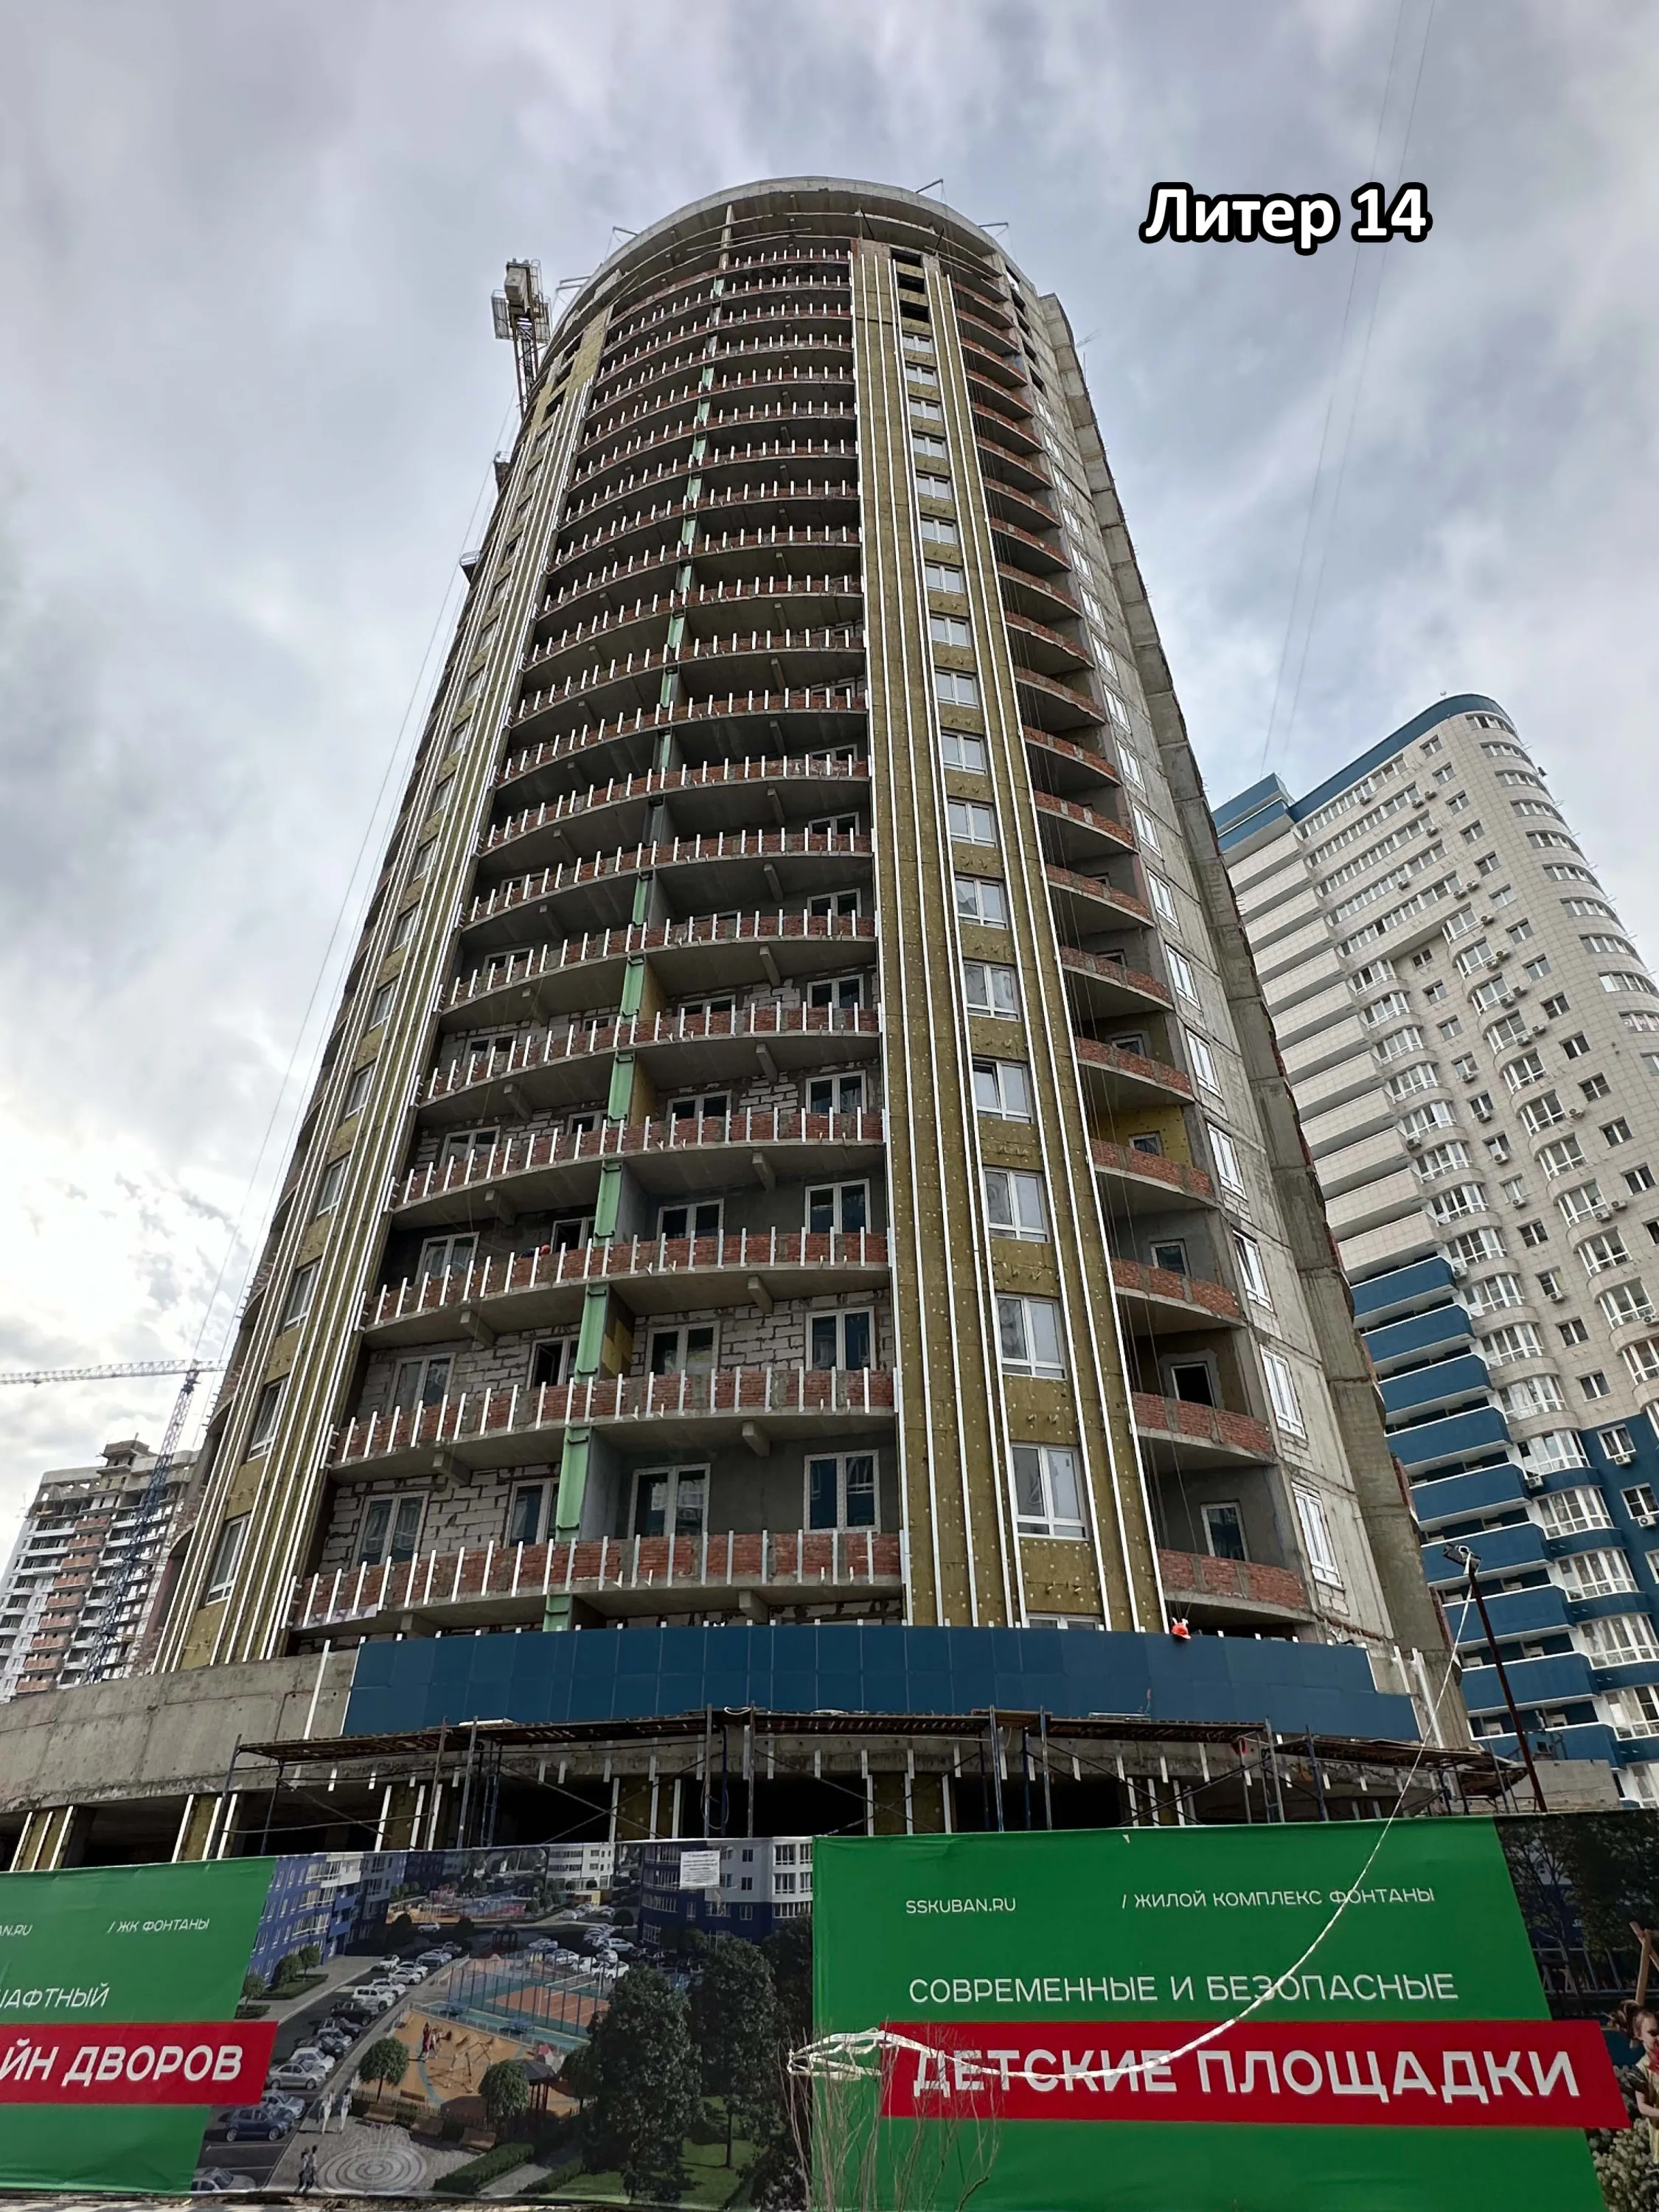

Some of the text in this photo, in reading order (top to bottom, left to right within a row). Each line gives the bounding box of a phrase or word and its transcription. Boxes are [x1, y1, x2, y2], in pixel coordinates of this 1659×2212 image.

[905, 1898, 1016, 1914] SSKUBAN.RU
[1134, 1890, 1207, 1908] ЖИЛОЙ
[1212, 1890, 1323, 1907] КОМПЛЕКС
[1329, 1888, 1435, 1905] ФОНТАНЫ
[116, 1920, 140, 1933] ЖК
[142, 1918, 210, 1933] ФОНТАНЫ
[908, 1973, 1459, 2003] СОВРЕМЕННЫЕ И БЕЗОПАСНЫЕ
[60, 2044, 243, 2087] ДВОРОВ
[913, 2048, 1581, 2104] ДЕТСКИЕ ПЛОЩАДКИ
